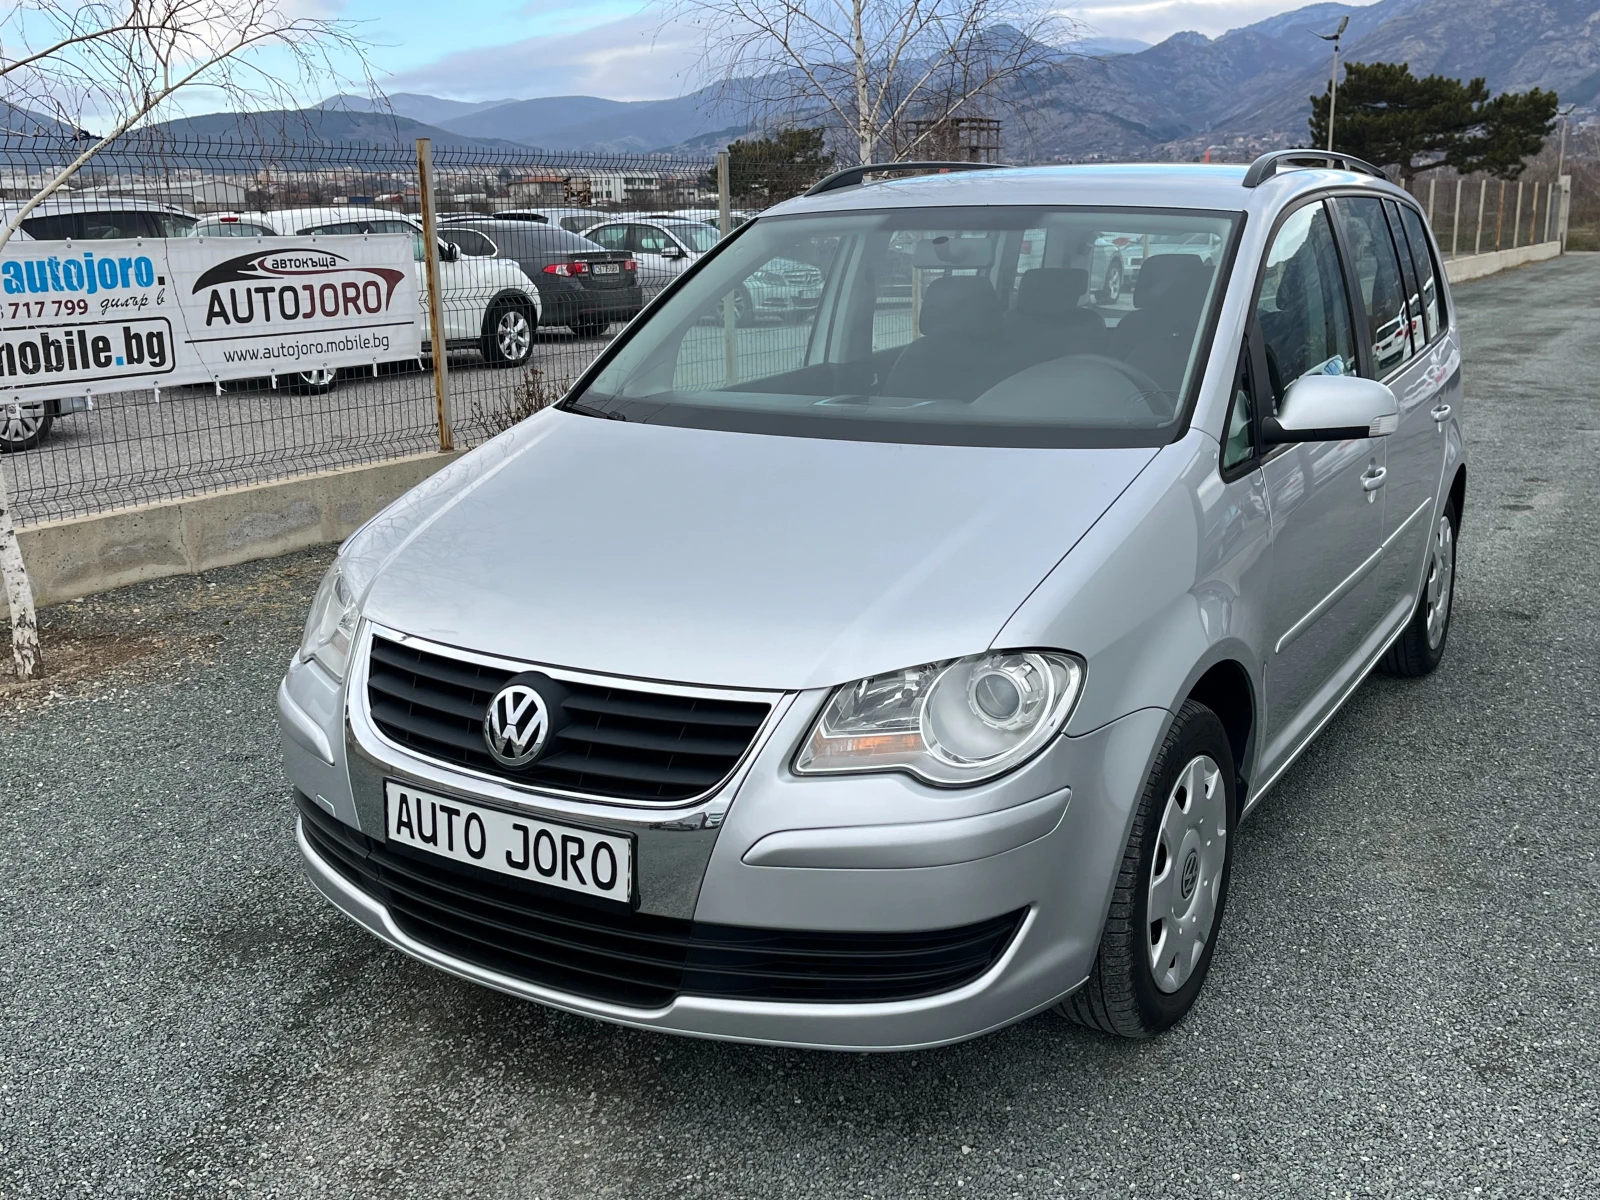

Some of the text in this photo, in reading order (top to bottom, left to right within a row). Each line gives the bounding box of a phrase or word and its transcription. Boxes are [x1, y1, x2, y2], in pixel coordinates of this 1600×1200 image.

[271, 257, 337, 269] автокъща
[8, 301, 46, 319] 717
[51, 299, 89, 316] 799
[99, 293, 149, 315] дилър
[205, 280, 382, 327] AUTOJORO
[223, 333, 390, 363] www.autojoro.mobile.bg
[396, 793, 618, 891] AUTO JORO
